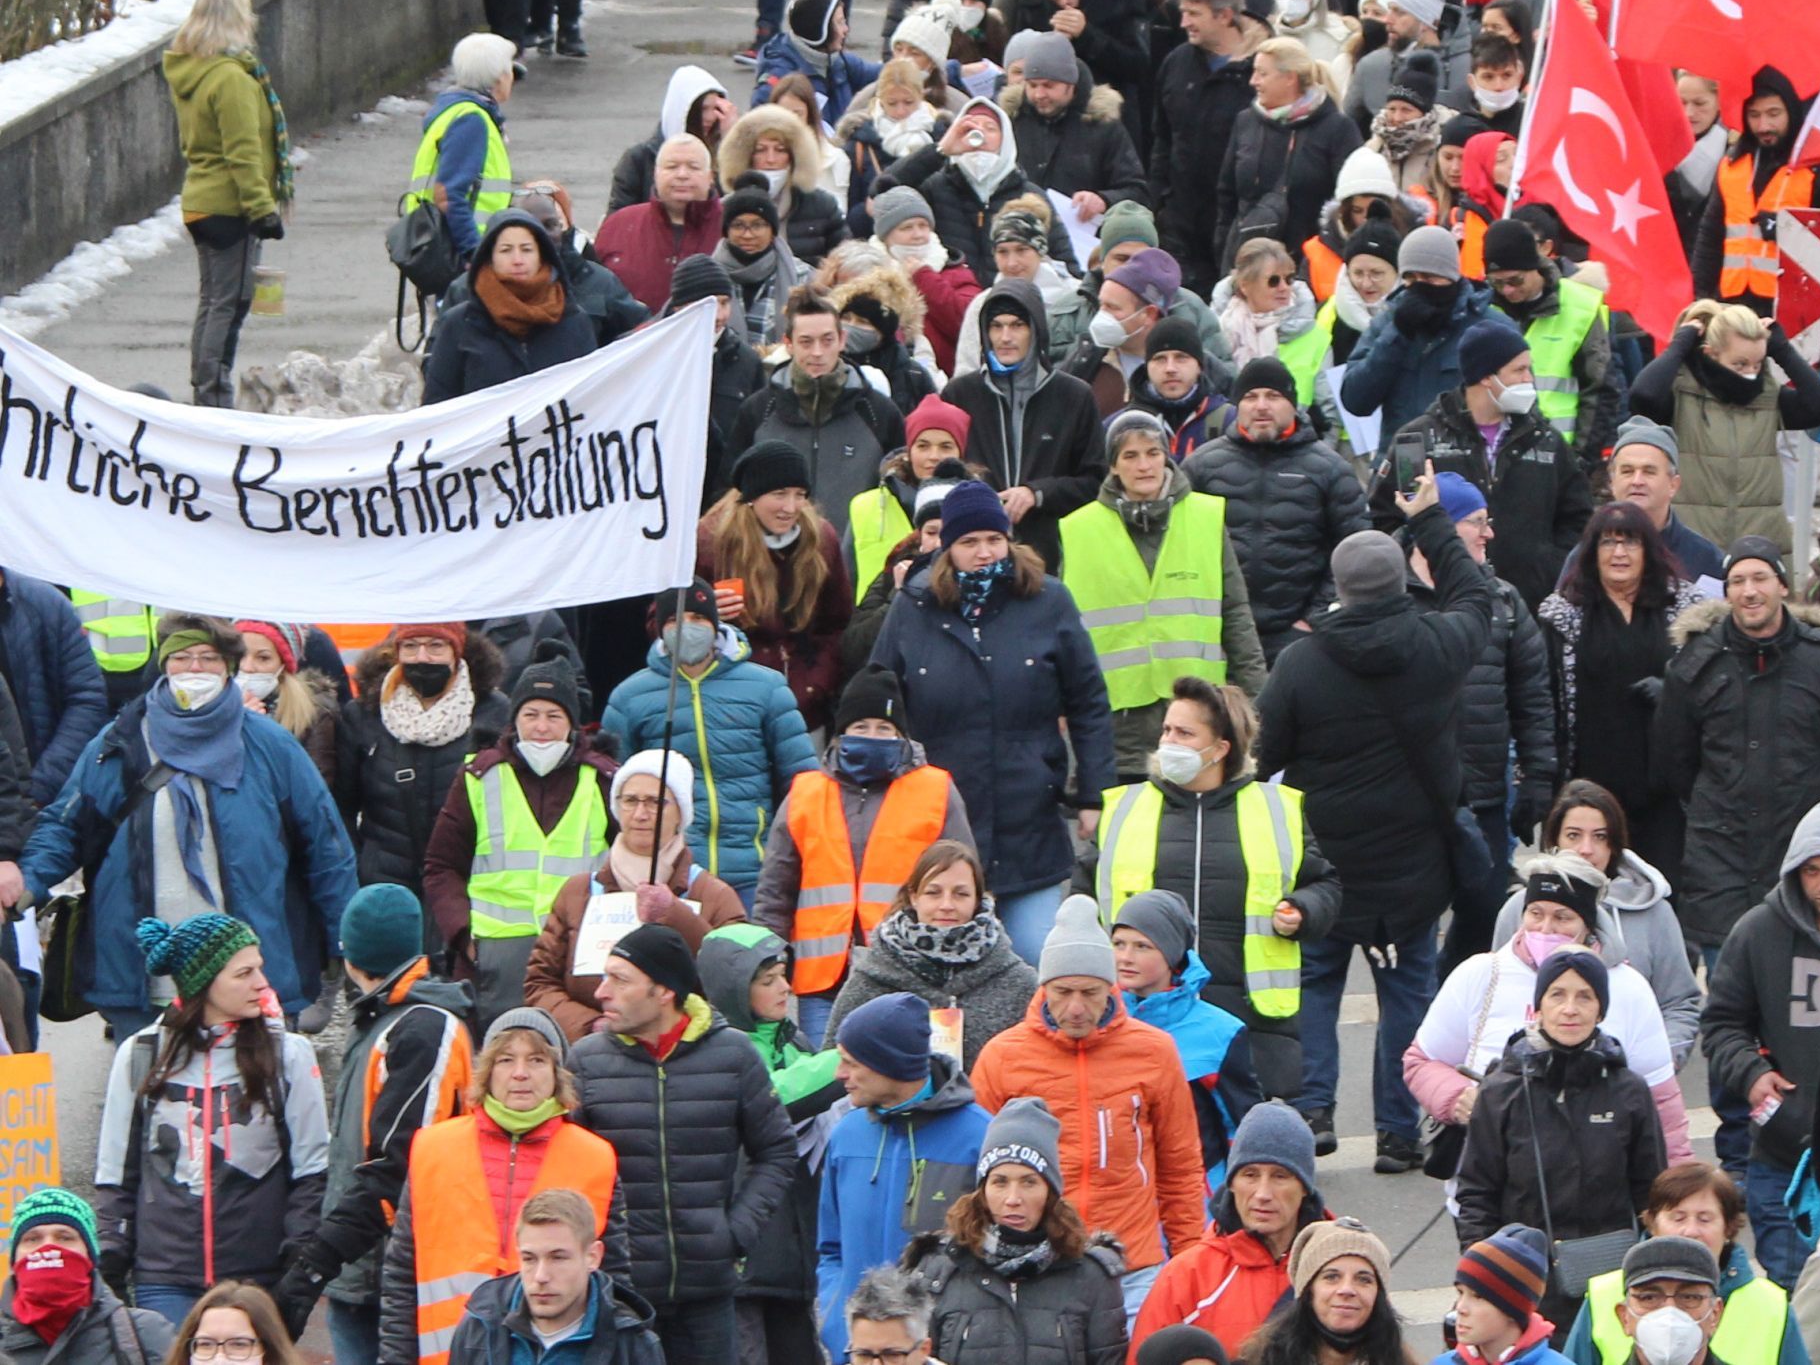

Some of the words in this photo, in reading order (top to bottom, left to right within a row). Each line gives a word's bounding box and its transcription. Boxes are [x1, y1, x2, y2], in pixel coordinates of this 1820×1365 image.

[0, 354, 212, 523] hrliche
[232, 398, 669, 540] Berichterstattung
[0, 1082, 54, 1130] ICHT
[0, 1137, 53, 1179] SAM
[1008, 1143, 1048, 1174] YORK
